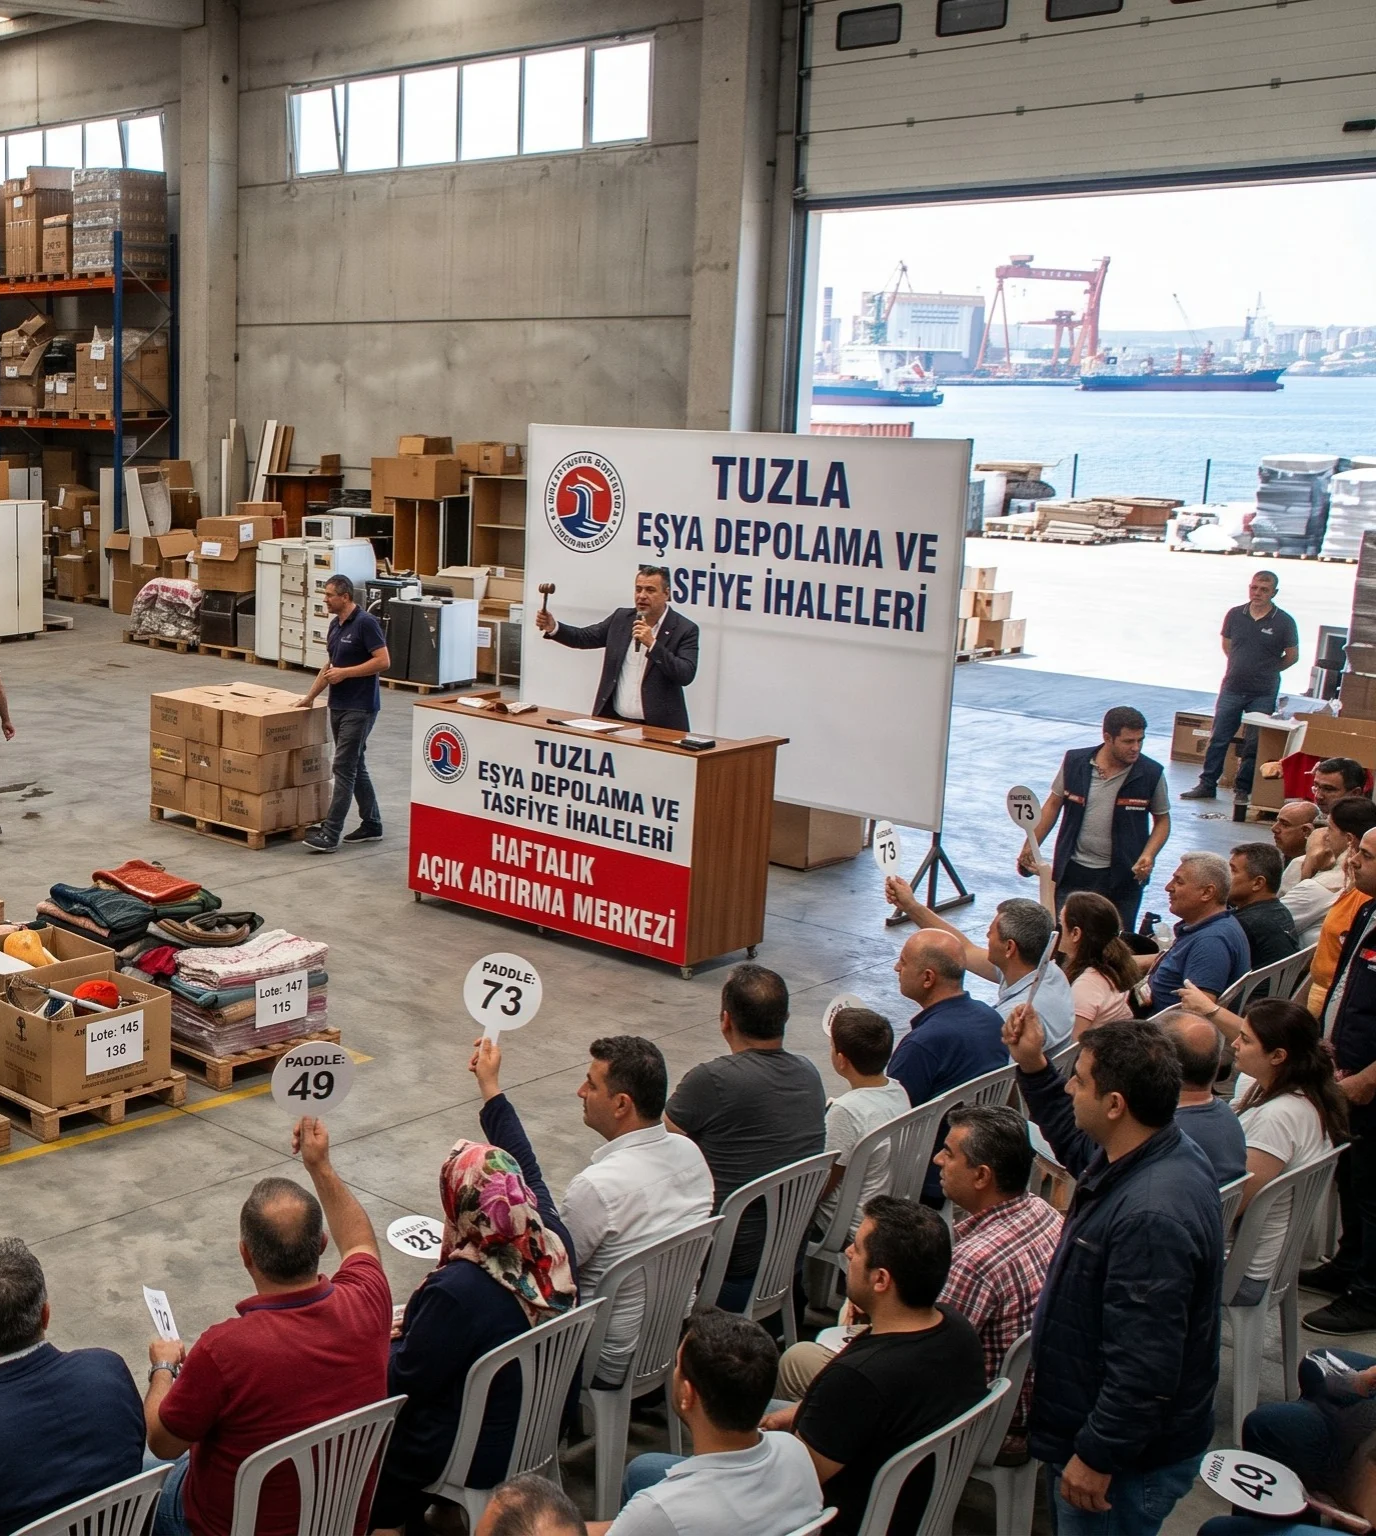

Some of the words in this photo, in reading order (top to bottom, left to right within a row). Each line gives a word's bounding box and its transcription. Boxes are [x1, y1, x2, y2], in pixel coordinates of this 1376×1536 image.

[712, 455, 850, 509] TUZLA
[637, 511, 704, 558] EŞYA
[714, 517, 883, 569] DEPOLAMA
[896, 531, 938, 574] VE
[763, 568, 927, 633] İHALELERİ
[534, 739, 616, 778] TUZLA
[478, 760, 524, 788] EŞYA
[531, 772, 644, 815] DEPOLAMA
[652, 796, 680, 823] VE
[481, 789, 558, 826] TASFİYE
[565, 804, 673, 852] İHALELERİ
[1013, 803, 1035, 821] 73
[491, 833, 596, 886] HAFTALIK
[879, 840, 896, 864] 73
[417, 852, 465, 891] AÇIK
[469, 866, 566, 918] ARTIRMA
[572, 893, 676, 948] MERKEZİ
[259, 987, 282, 999] Lote:
[285, 979, 303, 993] 147
[482, 961, 536, 985] PADDLE:
[272, 1000, 291, 1014] 115
[481, 978, 523, 1016] 73
[90, 1029, 117, 1043] Lote:
[120, 1020, 139, 1035] 145
[285, 1054, 345, 1068] PADDLE:
[287, 1070, 335, 1101] 49
[1230, 1463, 1278, 1502] 49
